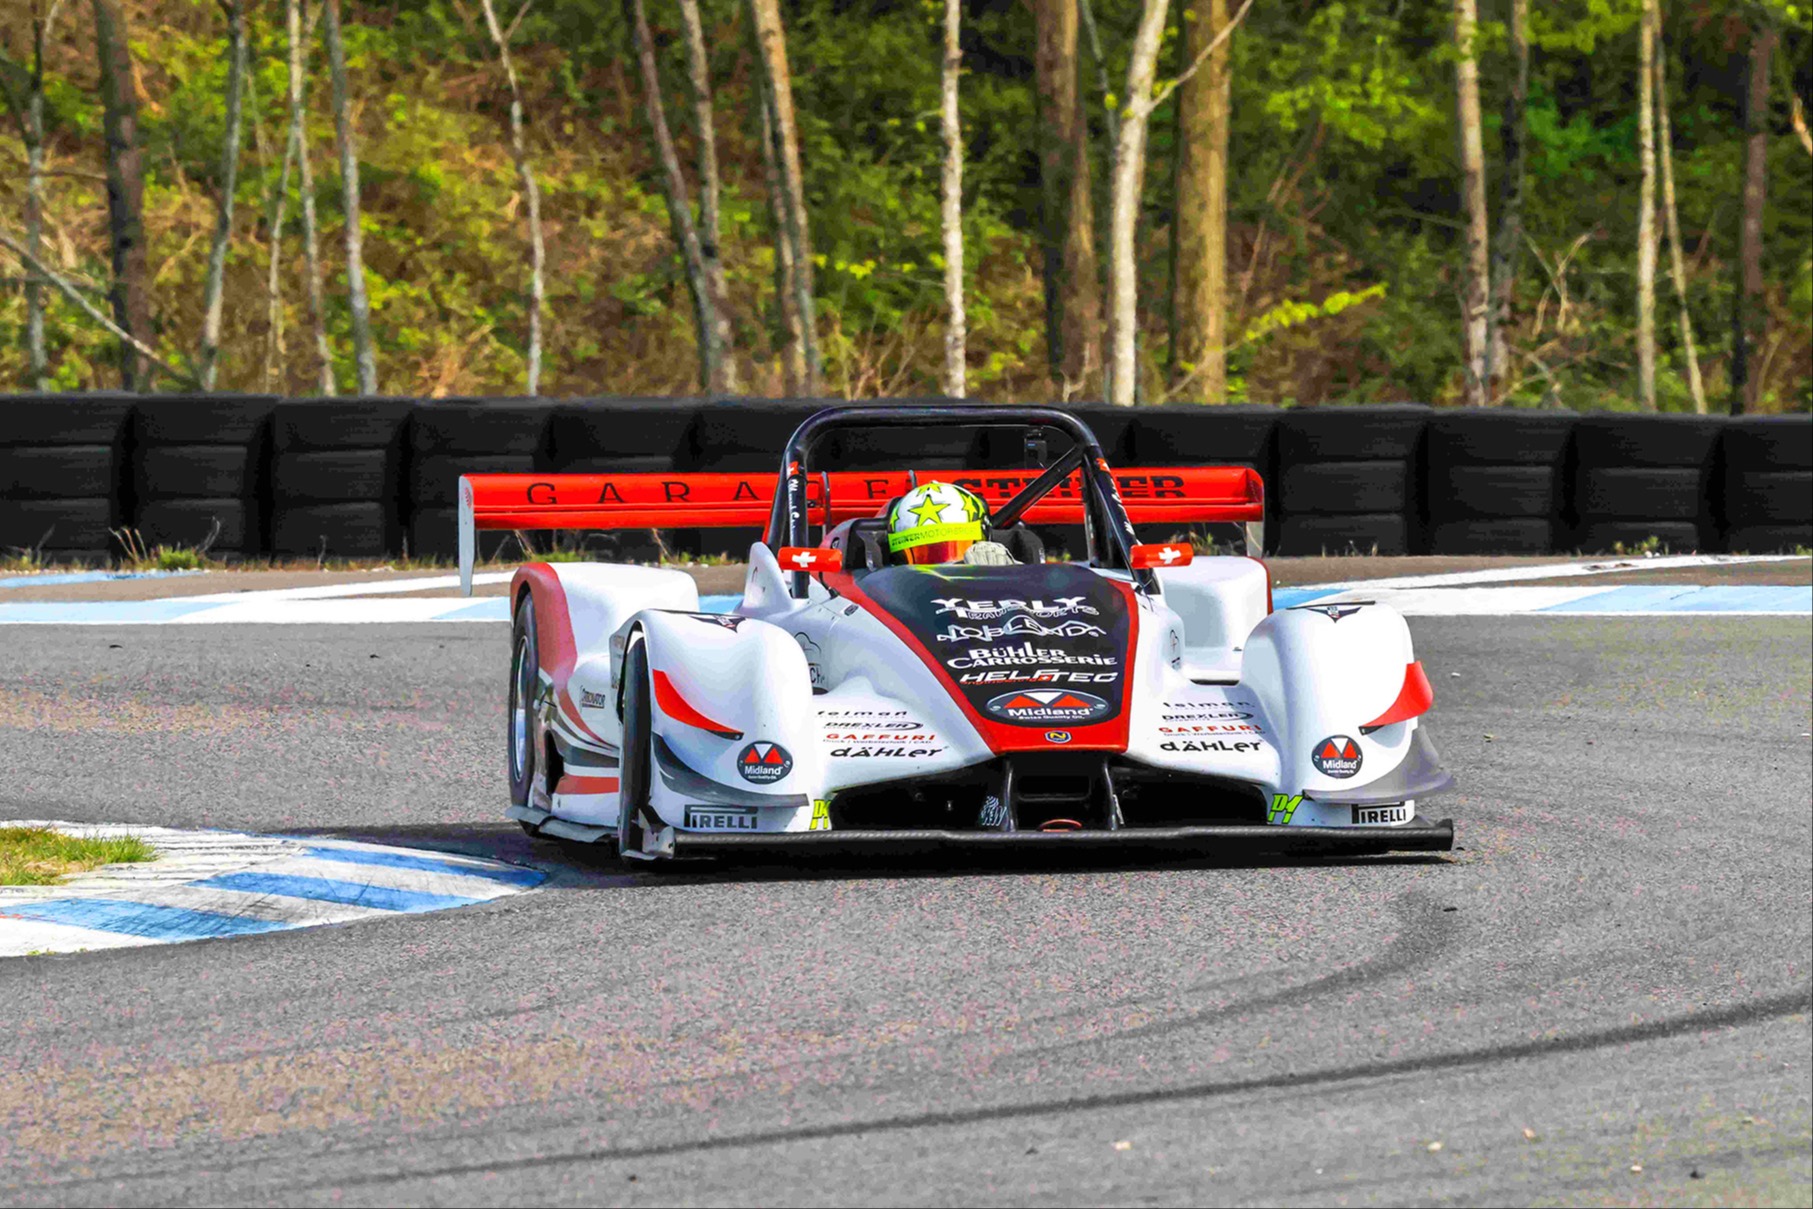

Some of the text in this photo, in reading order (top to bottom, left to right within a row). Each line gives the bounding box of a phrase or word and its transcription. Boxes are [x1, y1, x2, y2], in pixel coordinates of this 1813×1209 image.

[930, 597, 1086, 615] YERLY
[1008, 708, 1088, 717] Midland
[1159, 724, 1262, 732] GAFFURI
[1323, 760, 1357, 769] Midland
[745, 765, 782, 775] Midland
[684, 804, 758, 830] PIRELLI
[1352, 803, 1407, 824] PIRELLI
